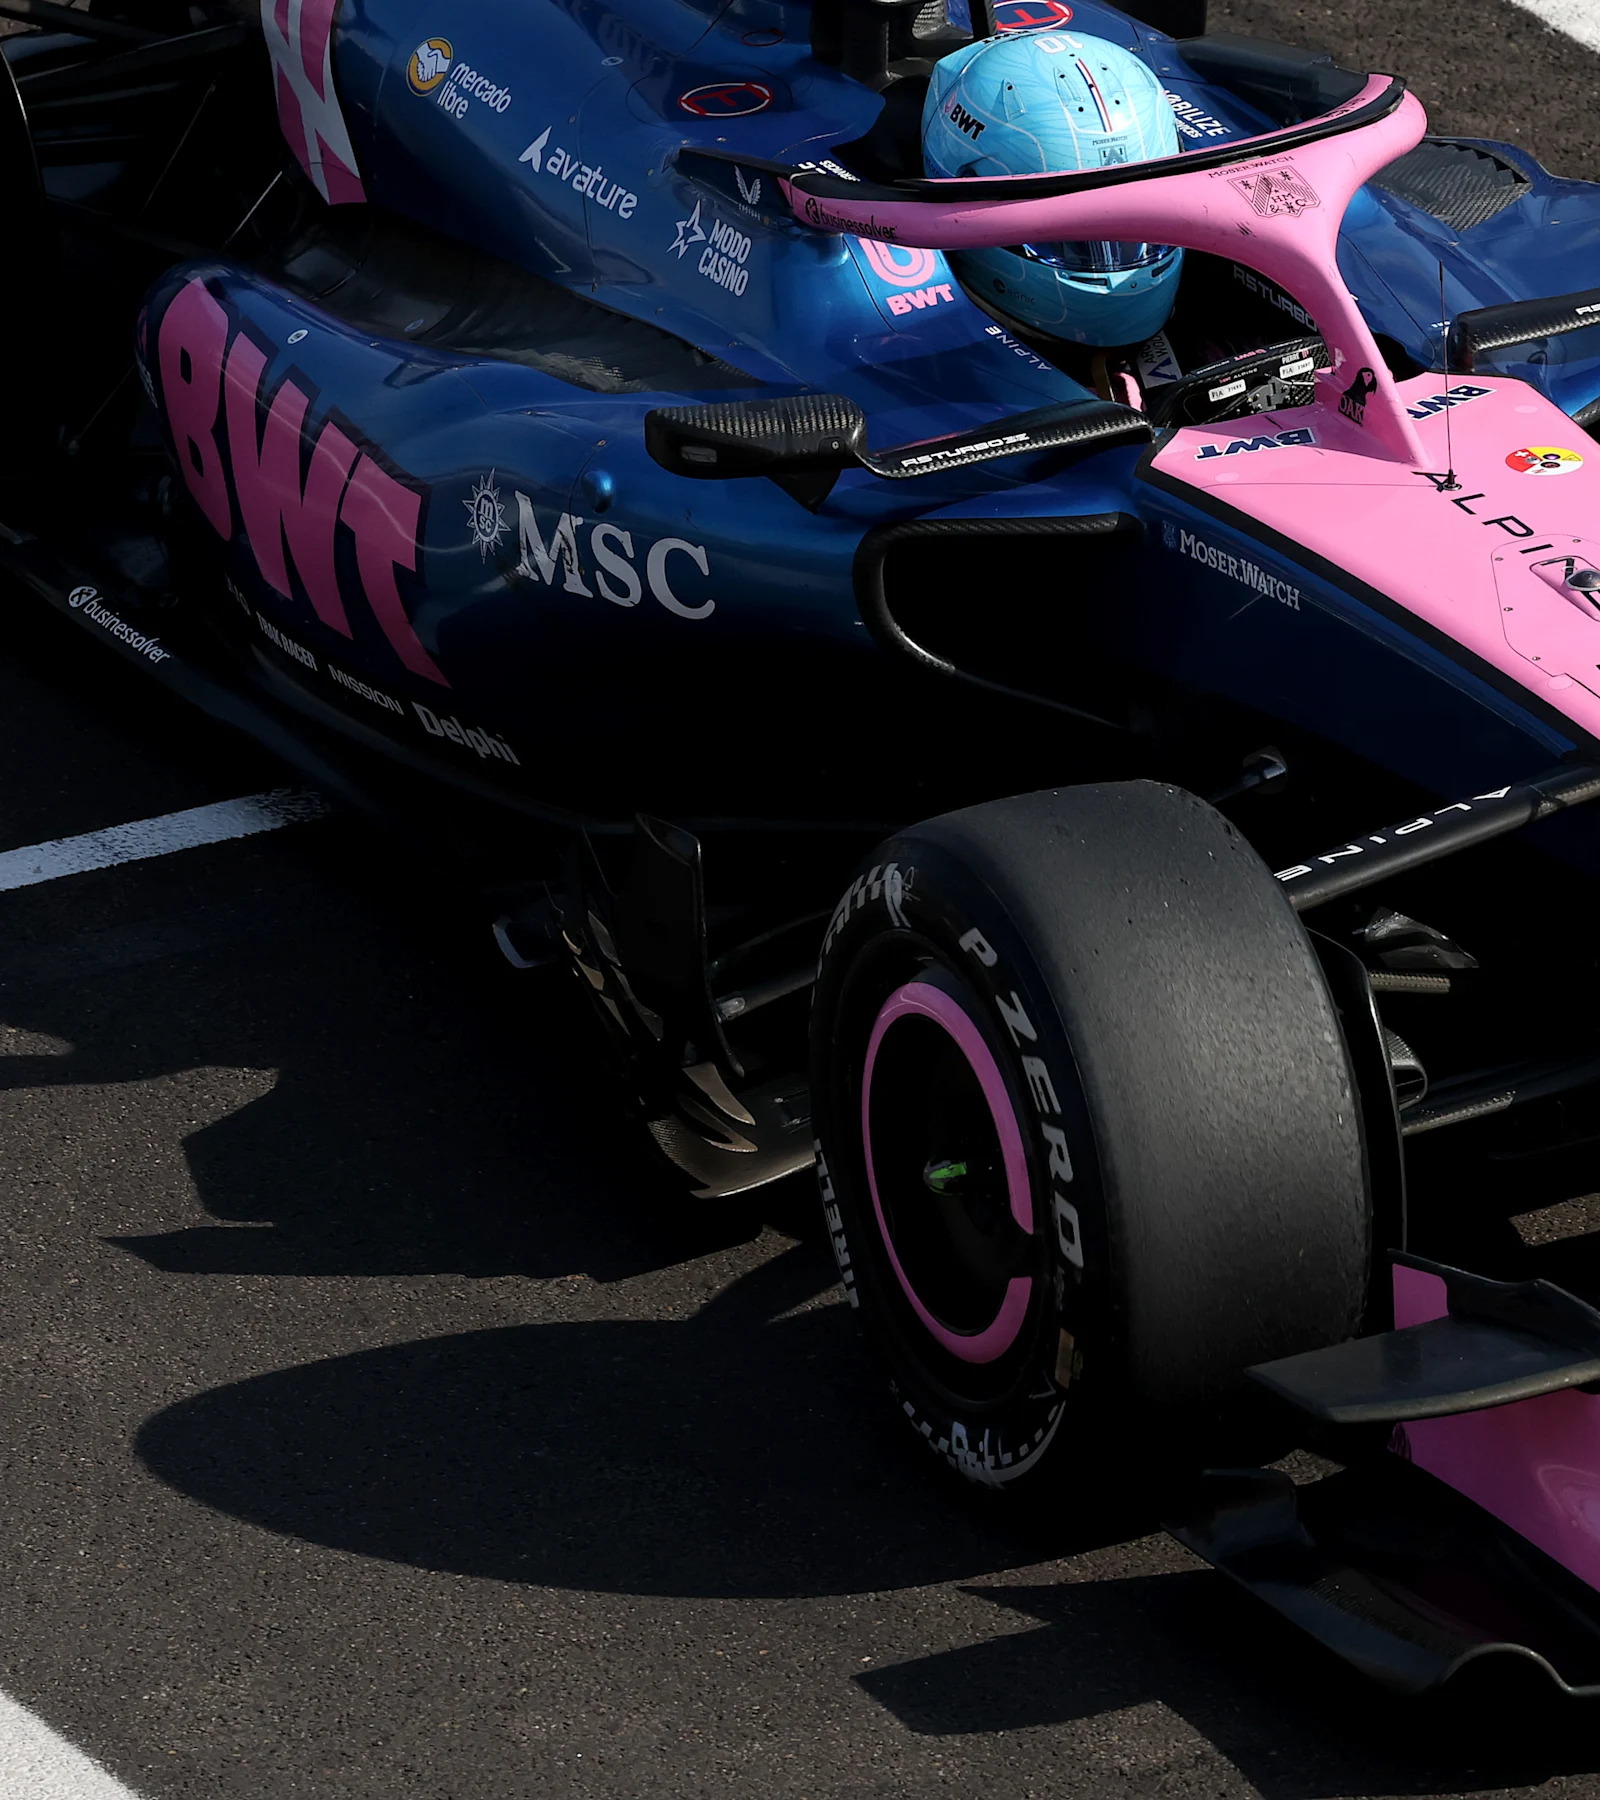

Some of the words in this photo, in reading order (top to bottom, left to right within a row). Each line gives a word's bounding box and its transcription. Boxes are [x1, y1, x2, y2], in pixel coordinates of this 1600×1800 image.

[436, 81, 470, 120] libre
[450, 61, 513, 114] mercado
[1163, 89, 1232, 137] ABILIZE
[950, 103, 986, 141] BWT
[546, 146, 639, 220] avature
[709, 218, 752, 265] MODO
[820, 204, 897, 240] businessolver
[698, 246, 750, 298] CASINO
[886, 284, 955, 316] BWT
[984, 325, 1053, 372] ALPINE
[1233, 367, 1258, 379] ALPINE
[1194, 427, 1317, 461] BWT
[157, 275, 455, 691] BWT
[514, 489, 716, 620] MSC
[82, 596, 172, 664] businessolver
[328, 663, 405, 716] MISSION
[411, 700, 523, 766] Delphi
[1273, 786, 1512, 882] ALPINE
[957, 926, 999, 968] P
[994, 989, 1085, 1269] ZERO
